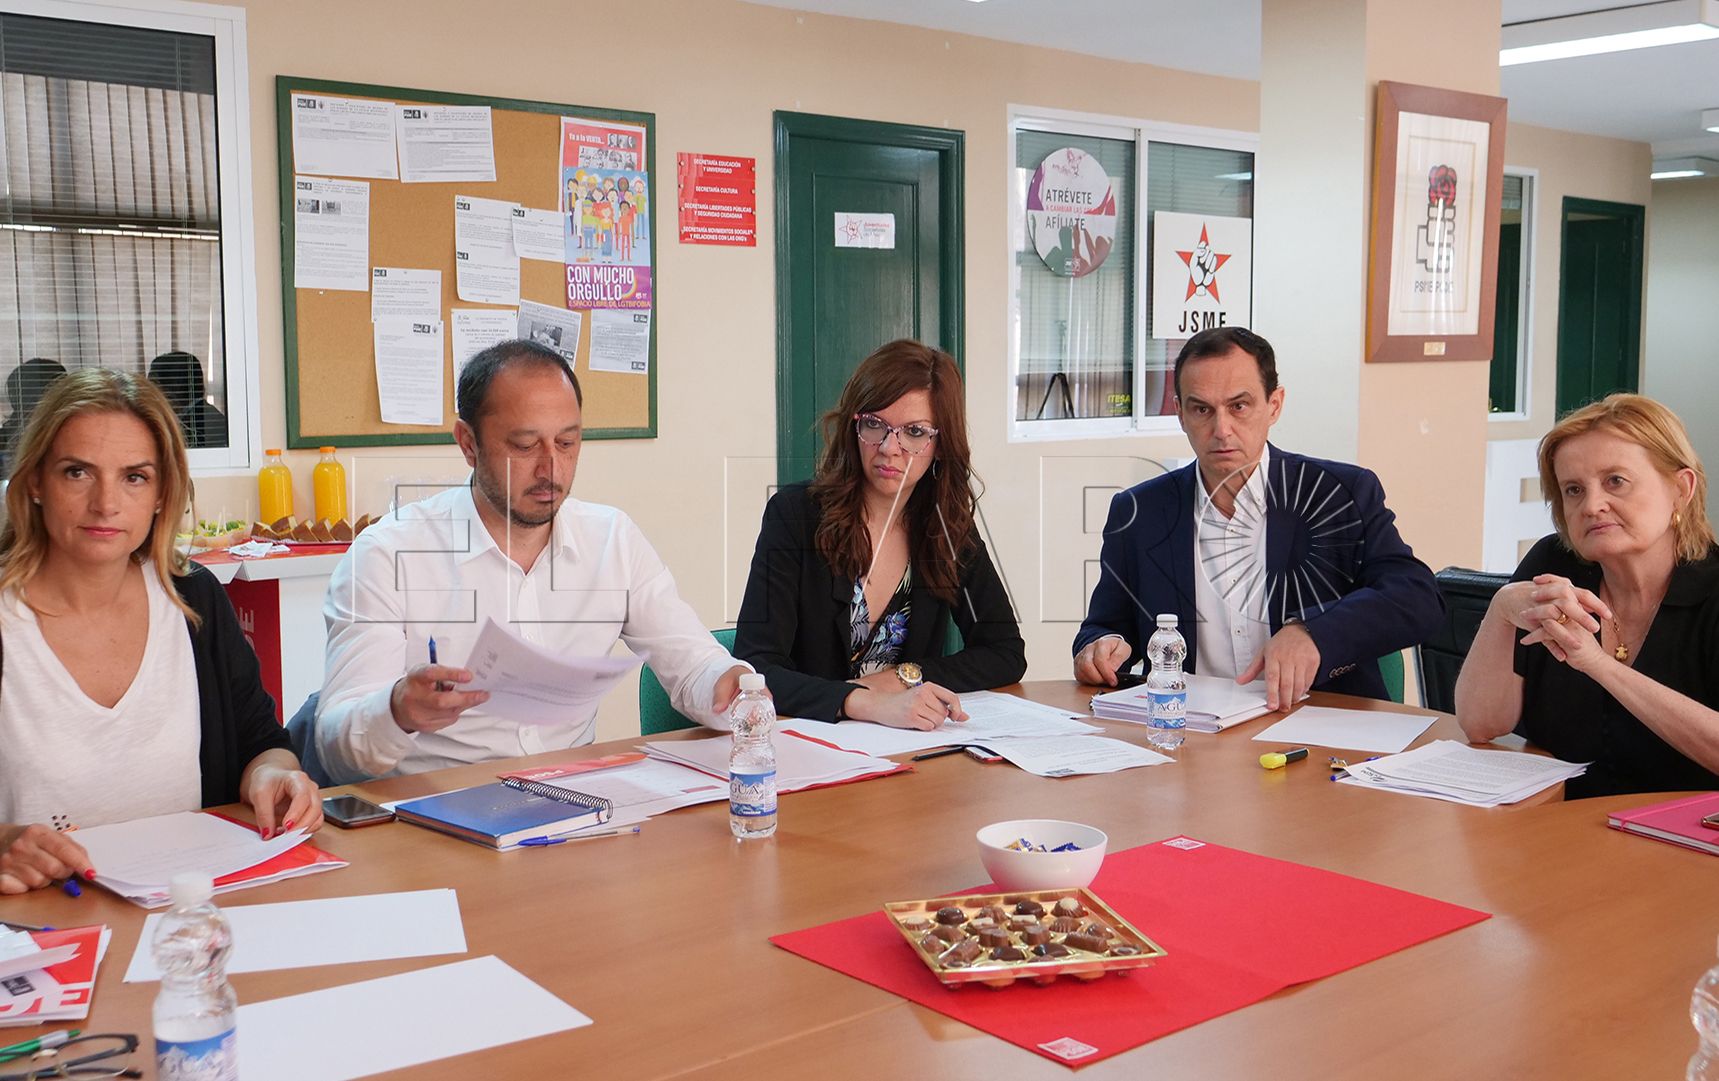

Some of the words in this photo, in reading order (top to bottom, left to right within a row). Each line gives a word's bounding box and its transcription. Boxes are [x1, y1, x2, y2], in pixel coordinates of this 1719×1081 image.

[718, 160, 742, 168] EDUCACIÓN
[1045, 187, 1092, 205] ATRÉVETE
[684, 202, 709, 210] SECRETARÍA
[709, 204, 733, 212] LIBERTADES
[1050, 204, 1072, 213] CAMBIAR
[1045, 214, 1086, 231] AFÍLIATE
[567, 266, 591, 283] CON
[593, 266, 635, 285] MUCHO
[568, 283, 623, 301] ORGULLO
[568, 300, 592, 308] ESPACIO
[593, 300, 609, 308] LIBRE
